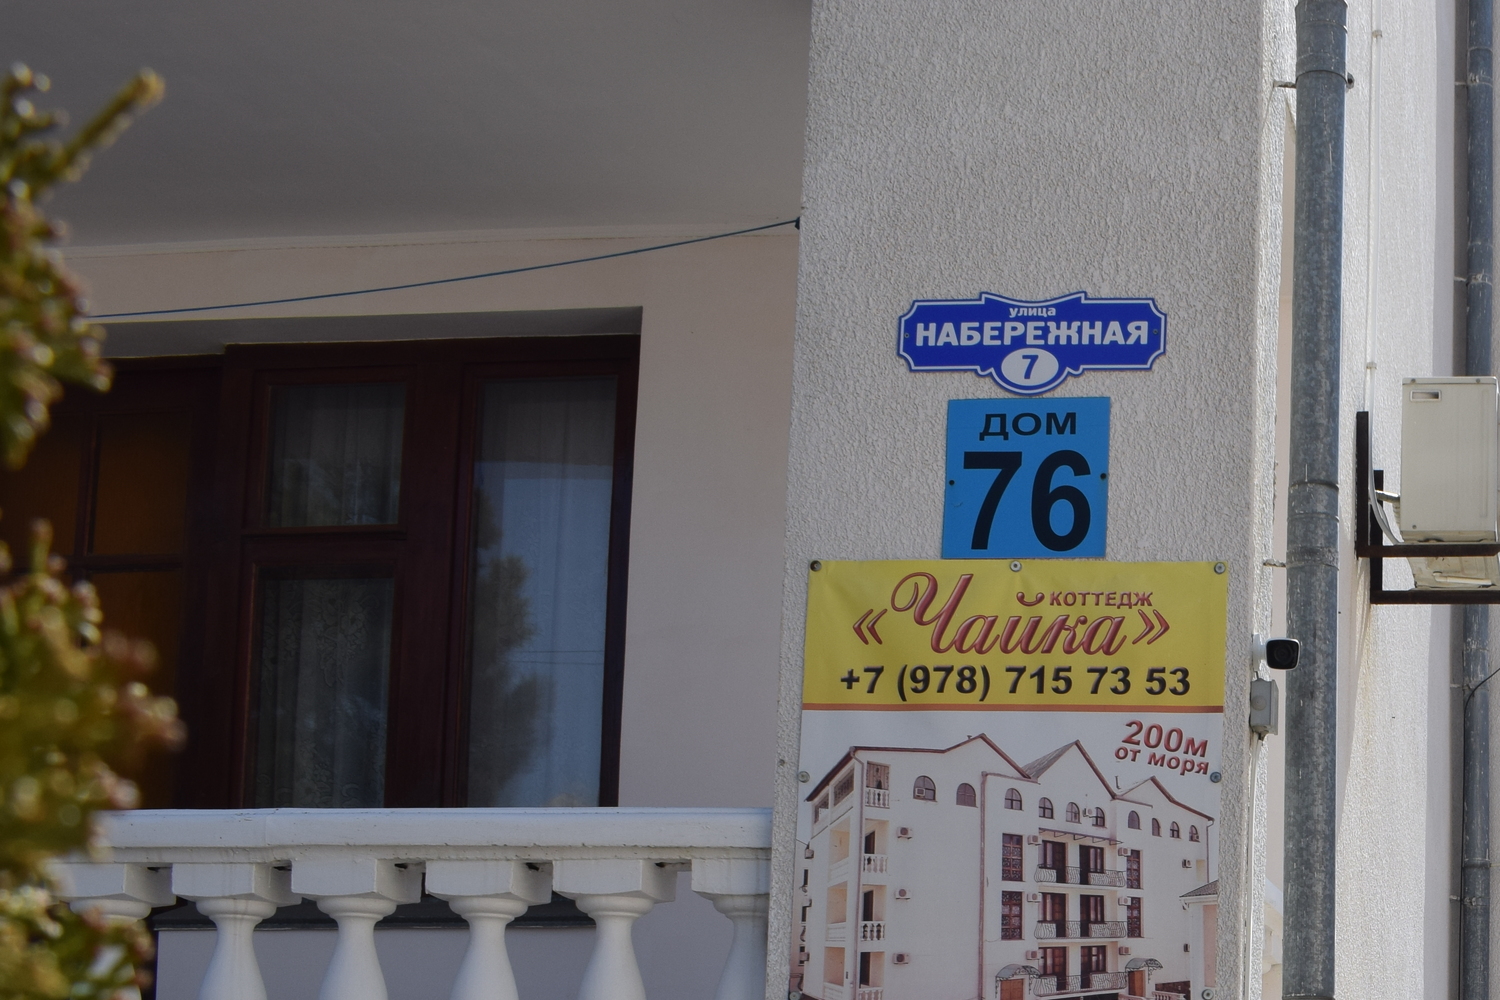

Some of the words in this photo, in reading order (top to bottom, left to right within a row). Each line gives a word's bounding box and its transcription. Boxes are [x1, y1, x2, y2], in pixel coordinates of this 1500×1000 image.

[1008, 306, 1056, 318] улица
[915, 321, 1148, 346] НАБЕРЕЖНАЯ
[1021, 354, 1039, 380] 7
[979, 412, 1077, 441] ДОМ
[963, 450, 1091, 551] 76
[1050, 591, 1153, 609] КОТТЕДЖ
[840, 666, 884, 694] +7
[897, 665, 990, 702] (978)
[1005, 666, 1072, 695] 715
[1087, 667, 1131, 695] 73
[1145, 667, 1190, 696] 53
[1114, 746, 1141, 762] от
[1147, 752, 1209, 776] моря
